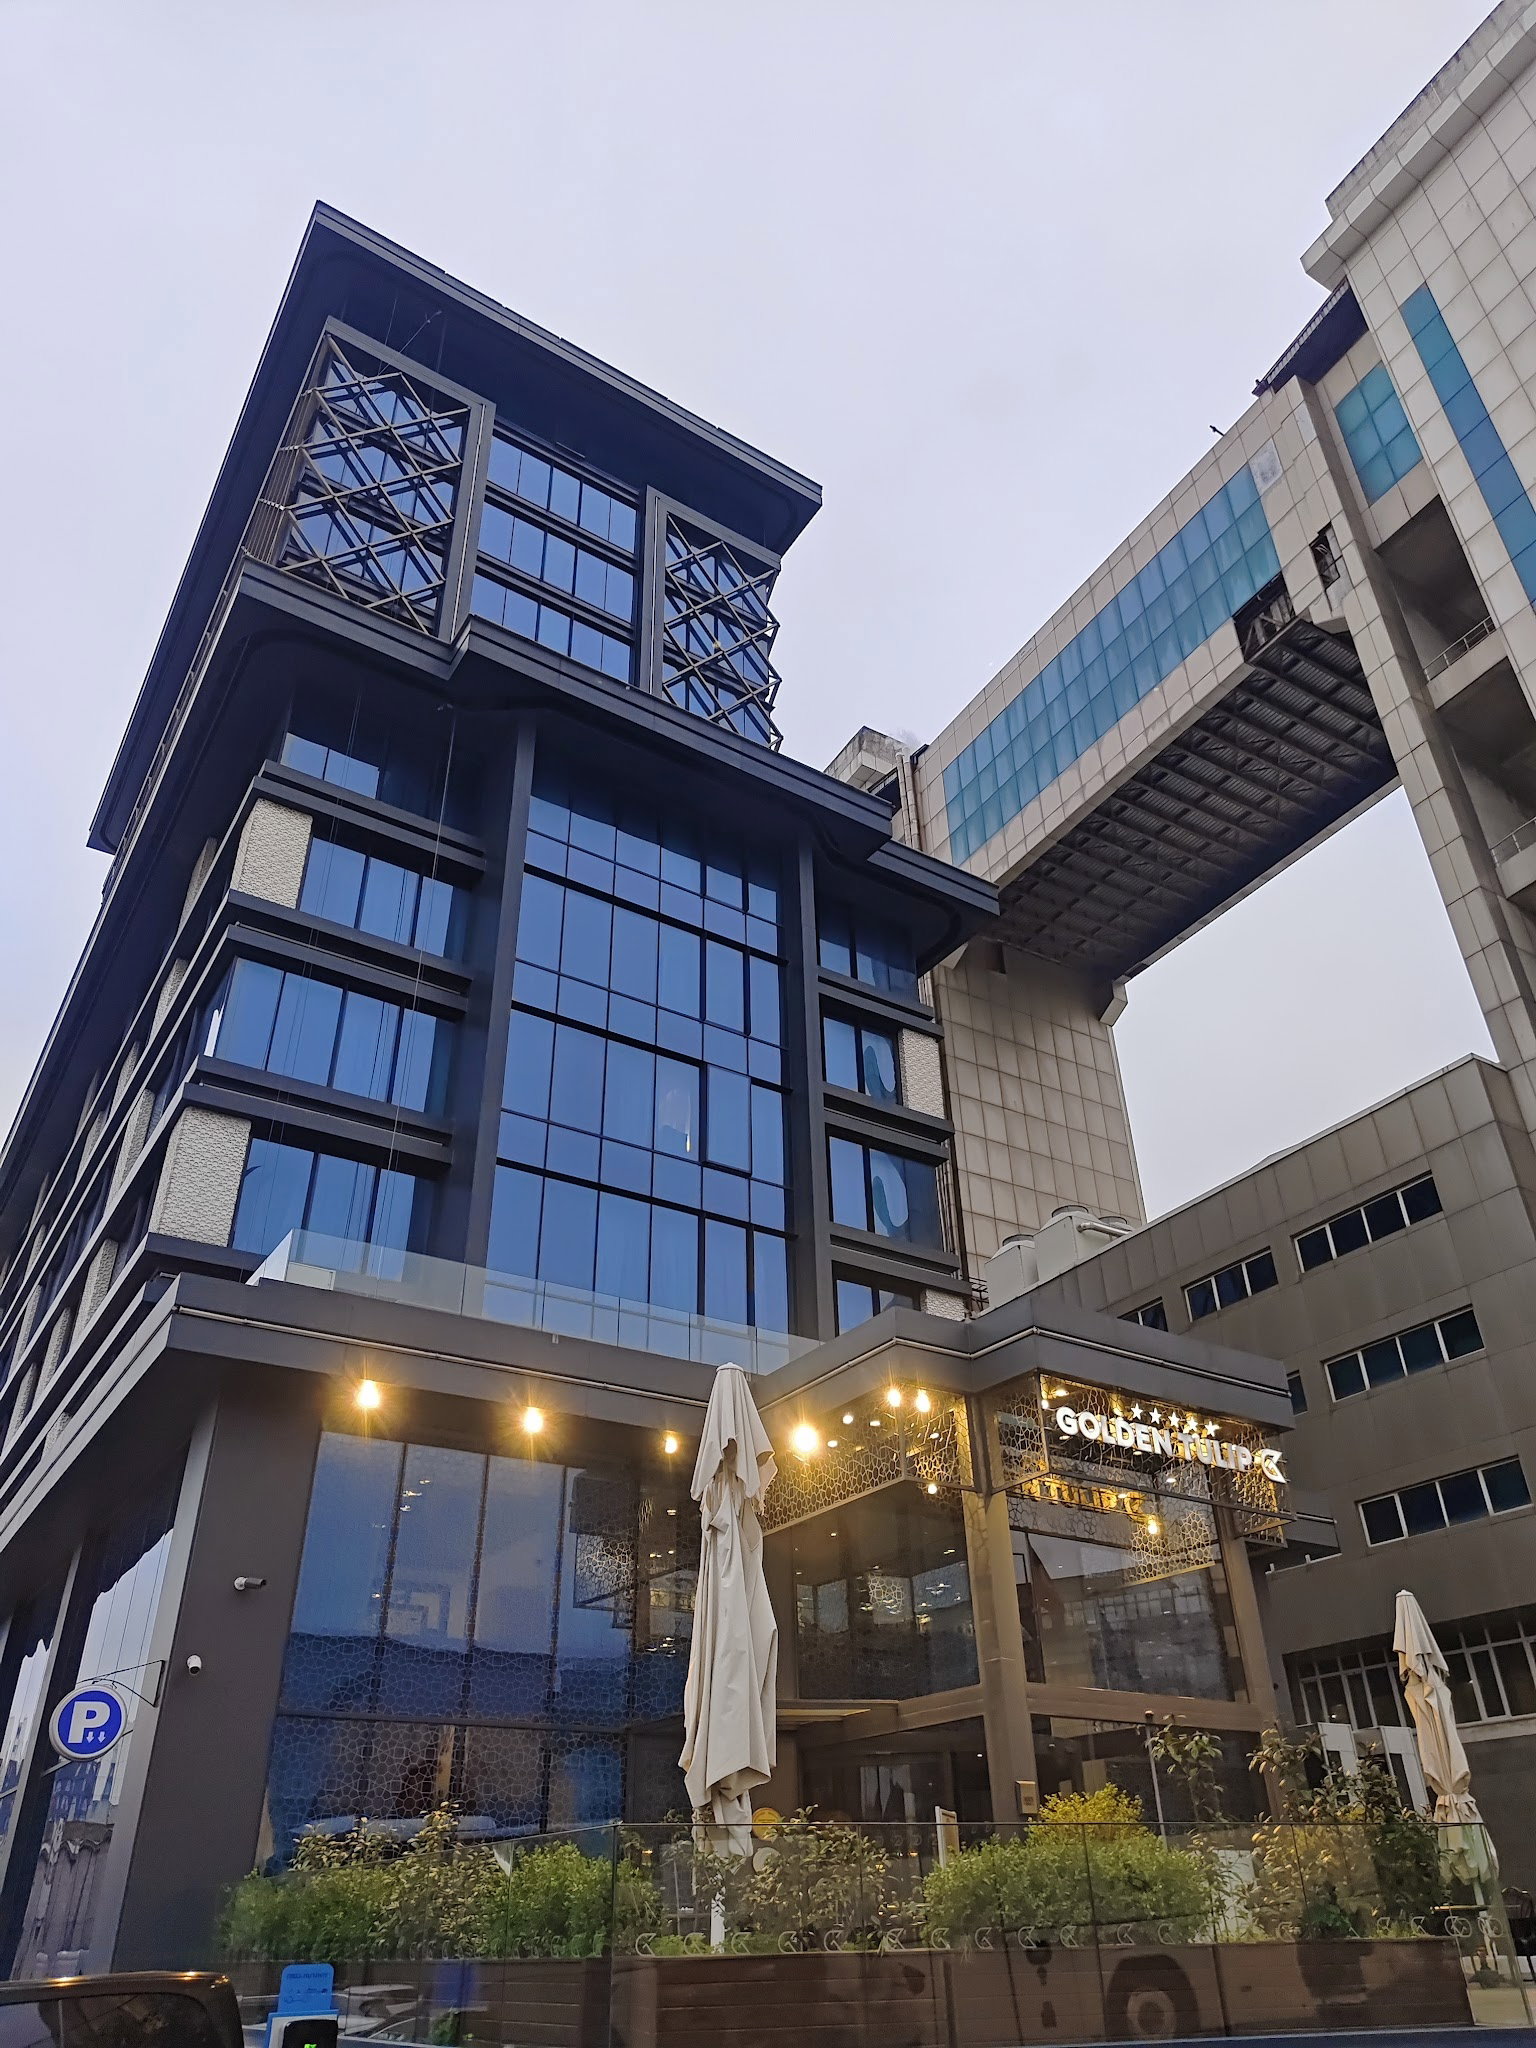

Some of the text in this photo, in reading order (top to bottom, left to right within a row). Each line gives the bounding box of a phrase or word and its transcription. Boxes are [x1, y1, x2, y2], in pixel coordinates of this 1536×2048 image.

[1056, 1406, 1253, 1472] GOLDEN TULIP
[68, 1701, 111, 1744] P
